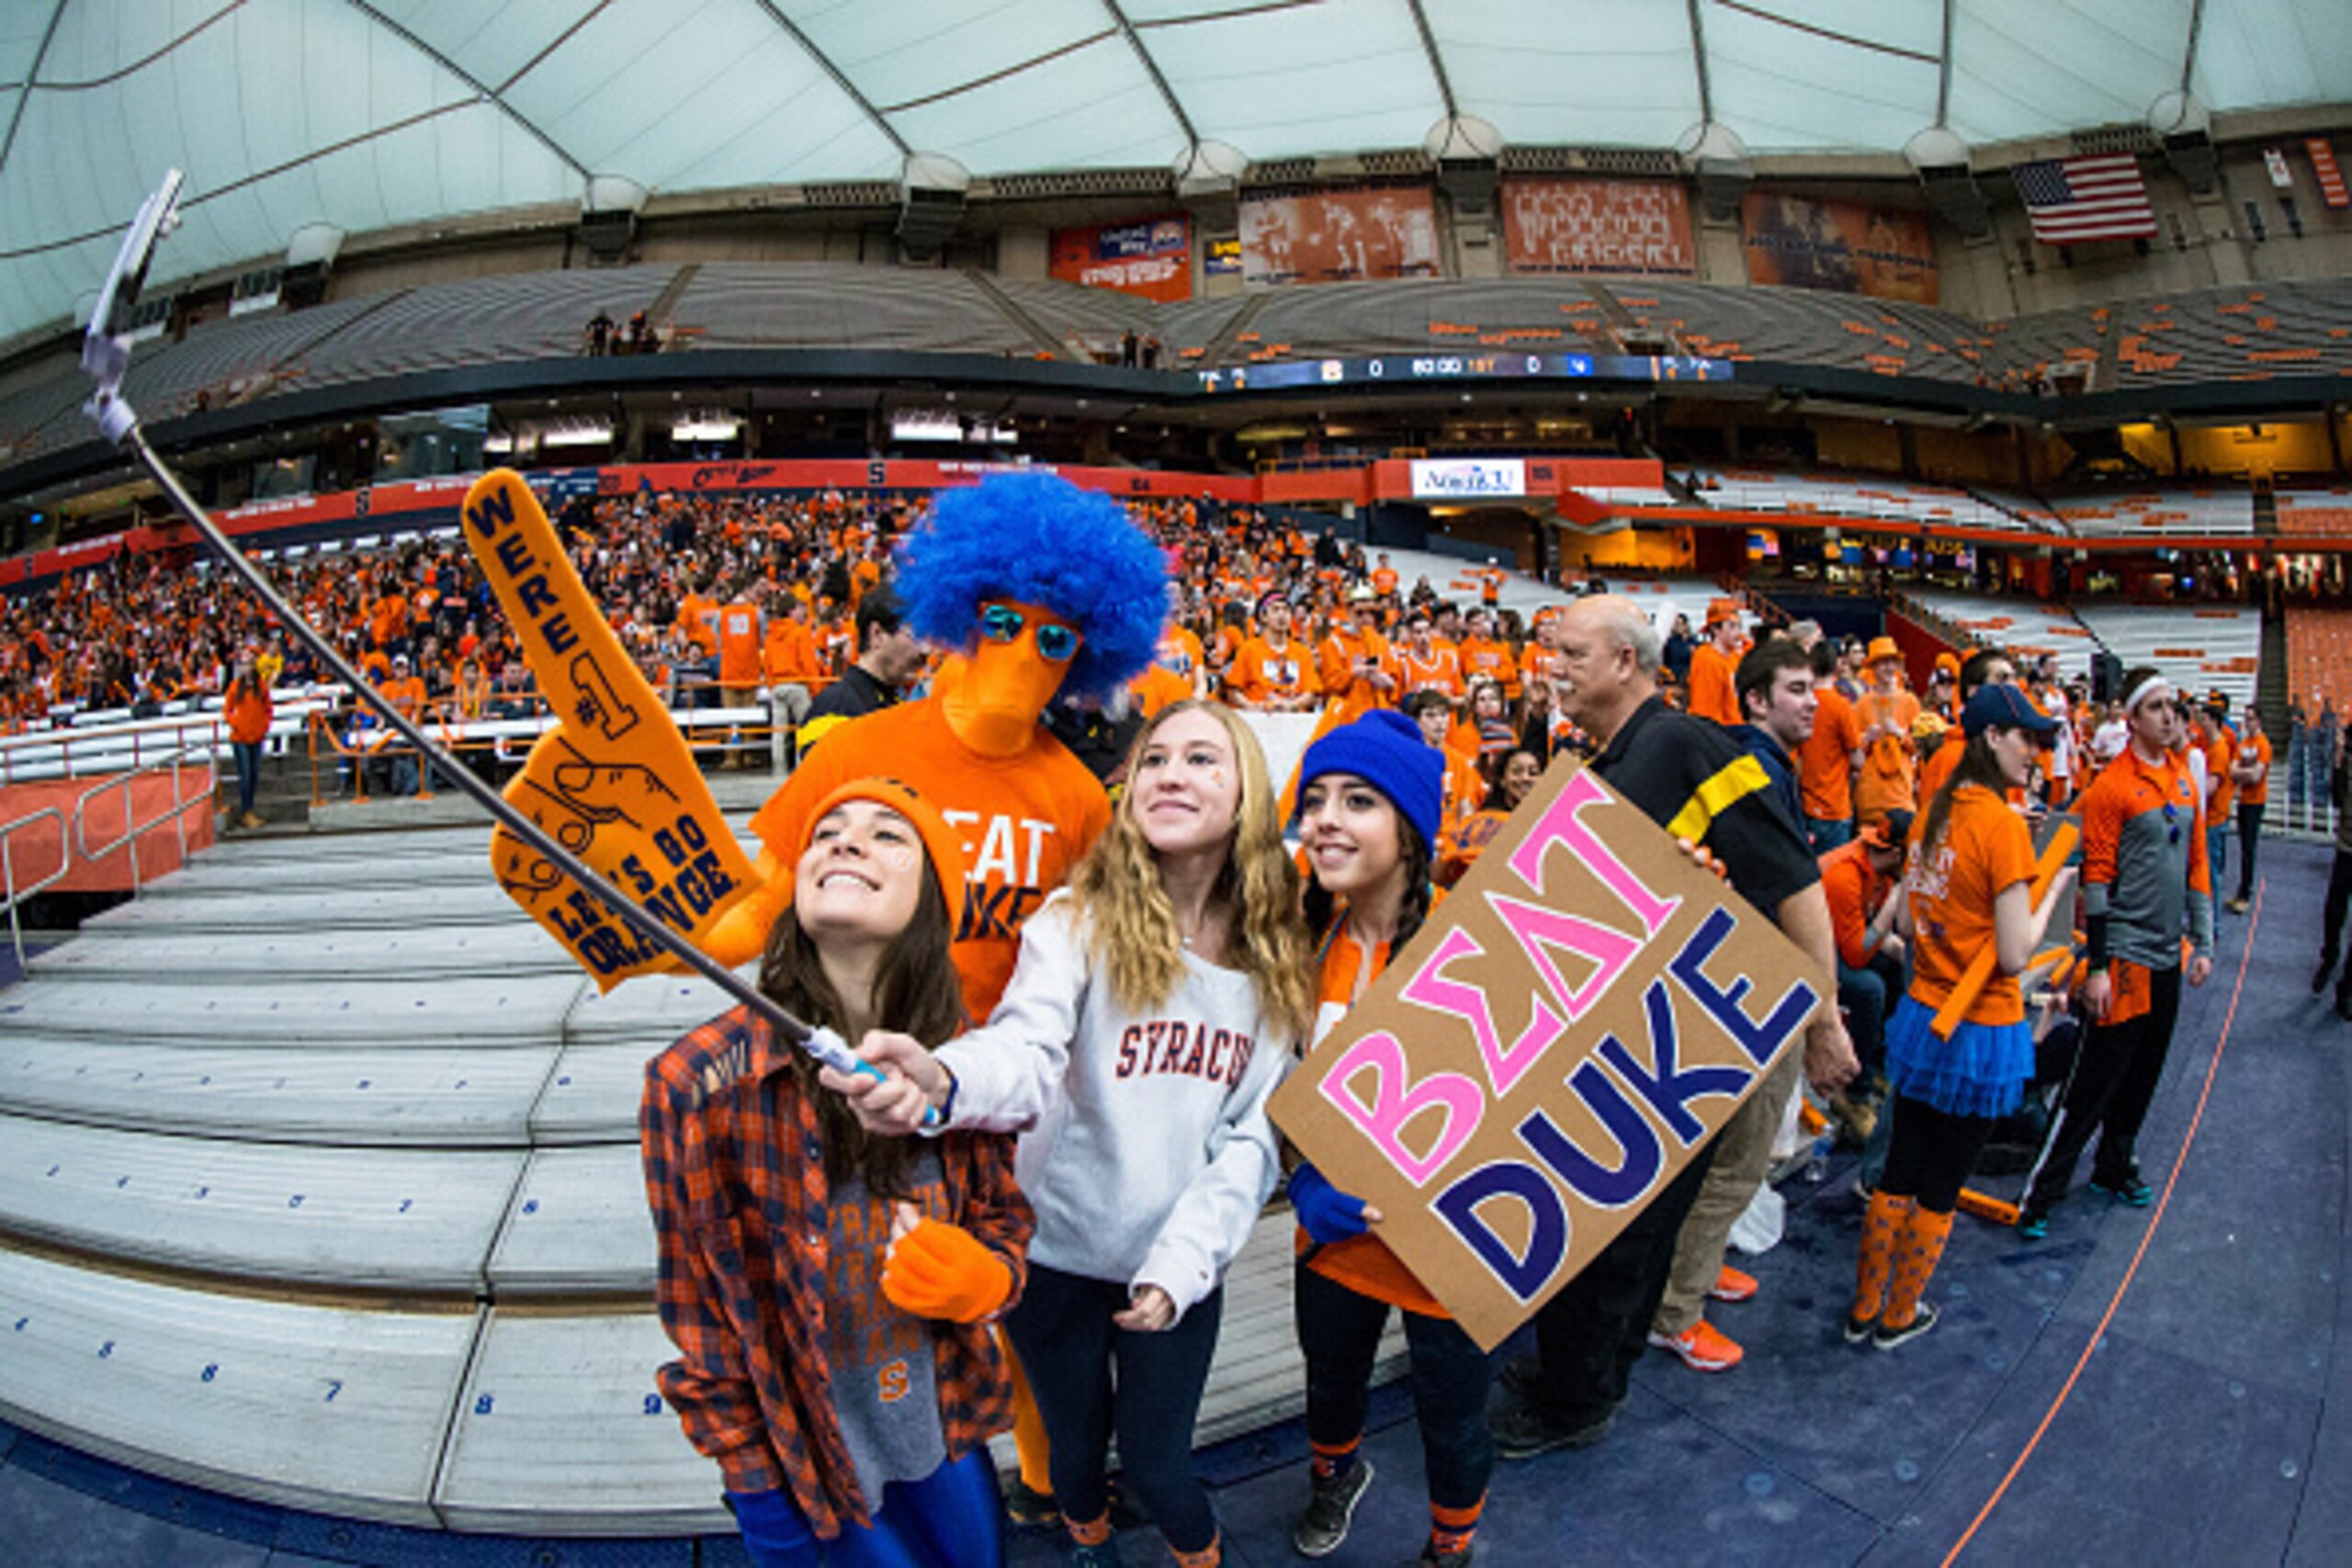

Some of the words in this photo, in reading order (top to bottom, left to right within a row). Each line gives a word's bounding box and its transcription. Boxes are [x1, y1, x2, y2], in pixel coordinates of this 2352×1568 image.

[1428, 904, 1822, 1307] DUKE
[324, 1381, 344, 1402] 7
[474, 1394, 494, 1415] 8
[644, 1393, 663, 1415] 9
[878, 1361, 910, 1403] S
